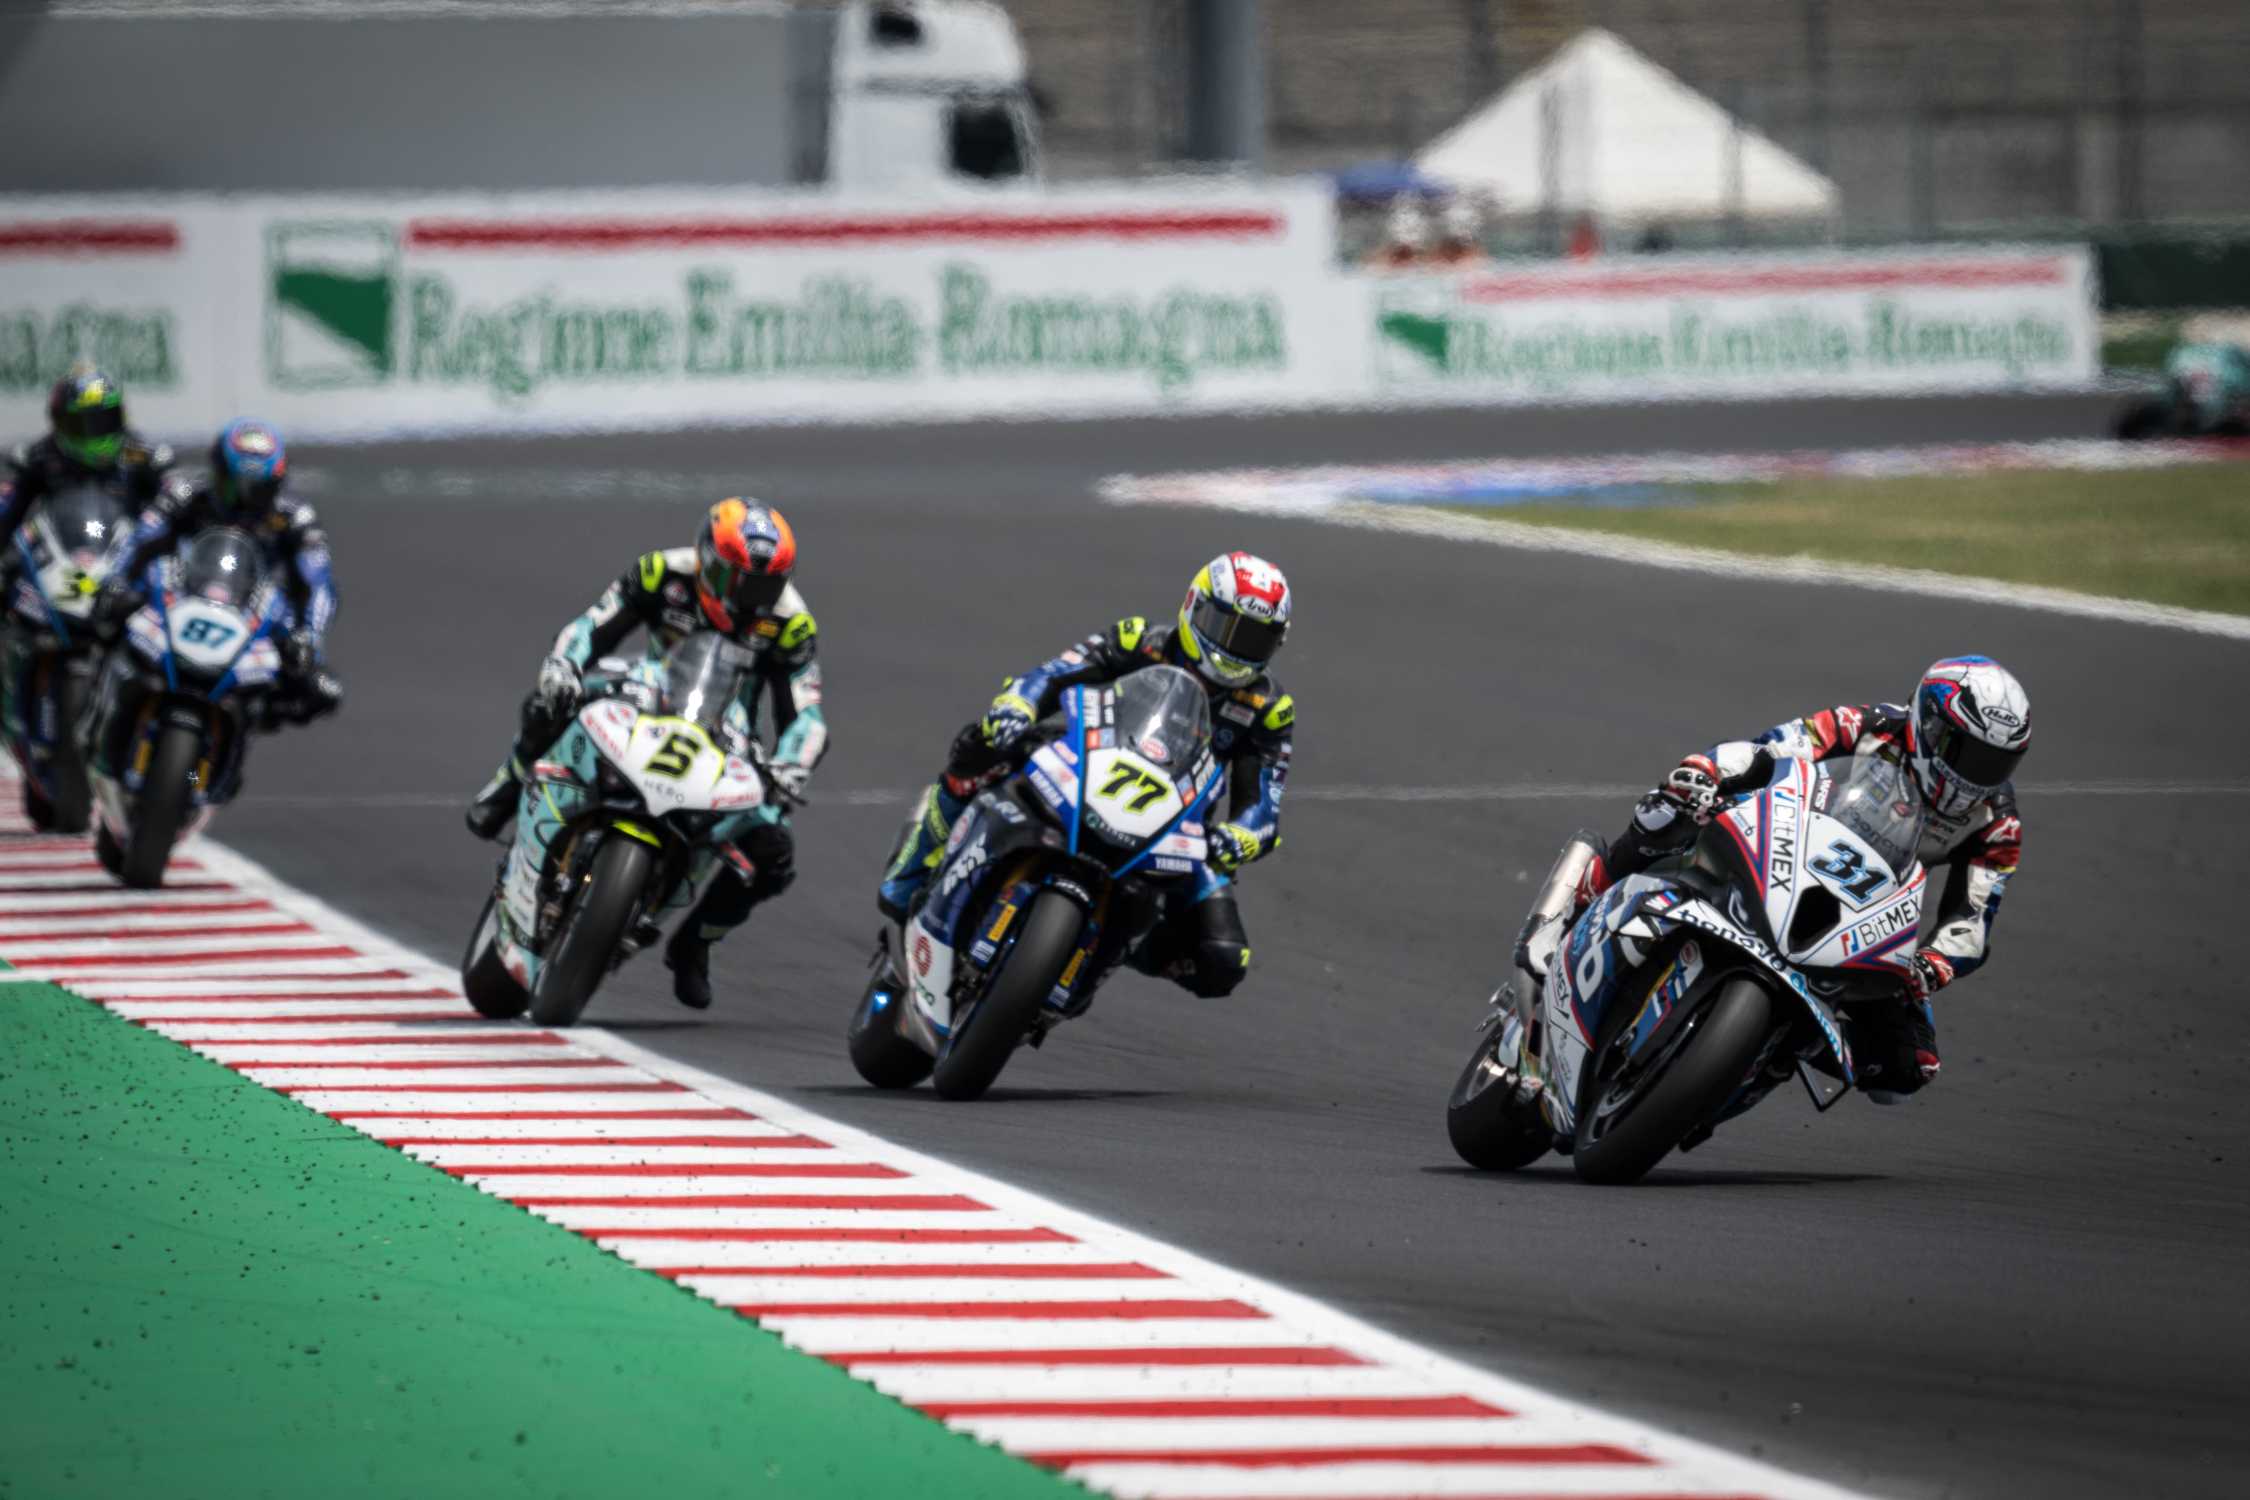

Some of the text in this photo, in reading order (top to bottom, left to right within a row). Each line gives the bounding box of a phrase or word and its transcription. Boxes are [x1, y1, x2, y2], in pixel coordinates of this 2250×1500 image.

[180, 617, 236, 648] 87
[1236, 598, 1275, 617] Arai
[1988, 708, 2017, 726] HJC
[645, 733, 700, 779] 5
[1099, 758, 1170, 814] 77
[1771, 803, 1796, 893] BitMEX
[1808, 839, 1888, 904] 31
[1678, 908, 1788, 972] bonovo
[1859, 896, 1920, 946] BitMEX
